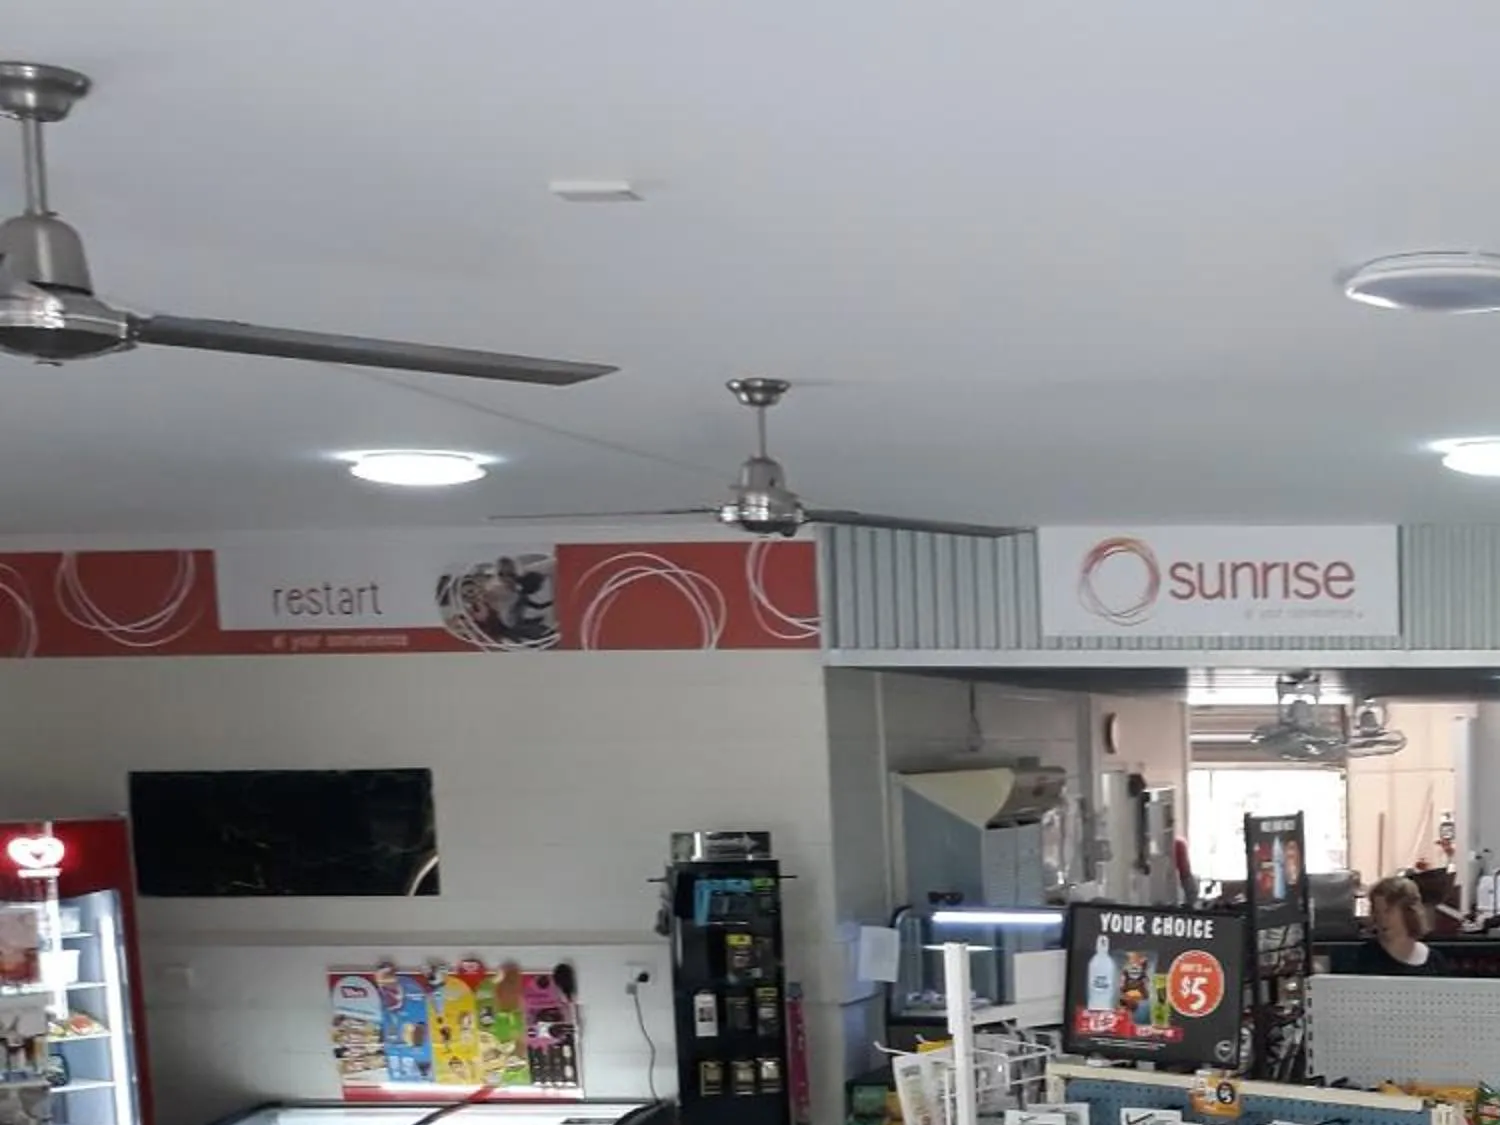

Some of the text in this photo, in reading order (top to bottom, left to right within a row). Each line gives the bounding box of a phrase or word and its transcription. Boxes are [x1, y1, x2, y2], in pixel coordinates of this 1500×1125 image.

[272, 579, 383, 616] restart
[1169, 561, 1356, 601] sunrise
[1099, 912, 1214, 939] YOUR CHOICE
[1179, 975, 1208, 1011] $5
